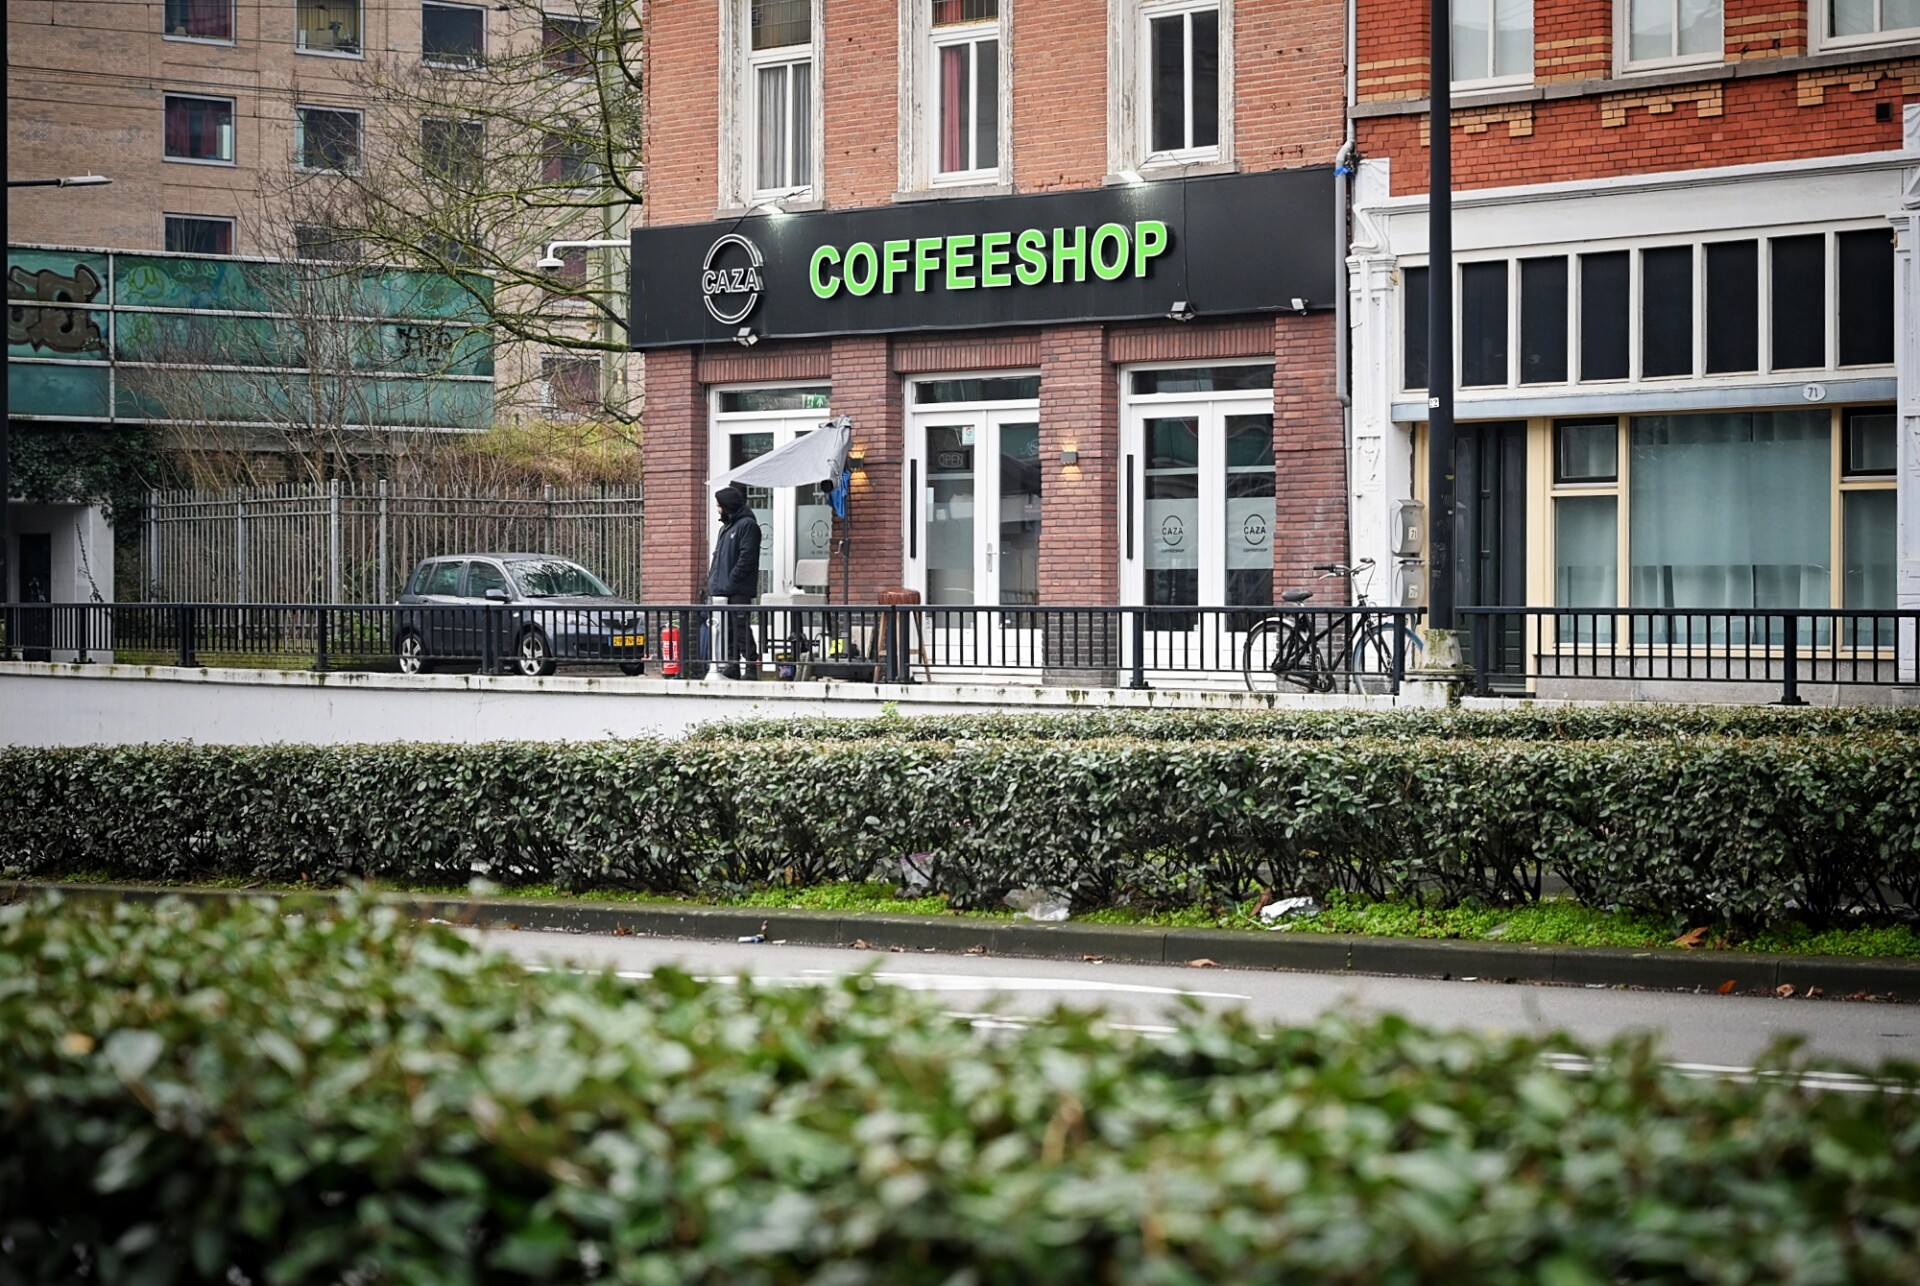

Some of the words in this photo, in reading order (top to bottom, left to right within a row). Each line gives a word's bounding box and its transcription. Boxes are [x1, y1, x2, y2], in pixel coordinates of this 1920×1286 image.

[809, 220, 1168, 299] COFFEESHOP
[702, 267, 760, 294] CAZA
[1807, 386, 1818, 398] 71
[1162, 527, 1183, 535] CAZA
[1244, 526, 1266, 535] CAZA
